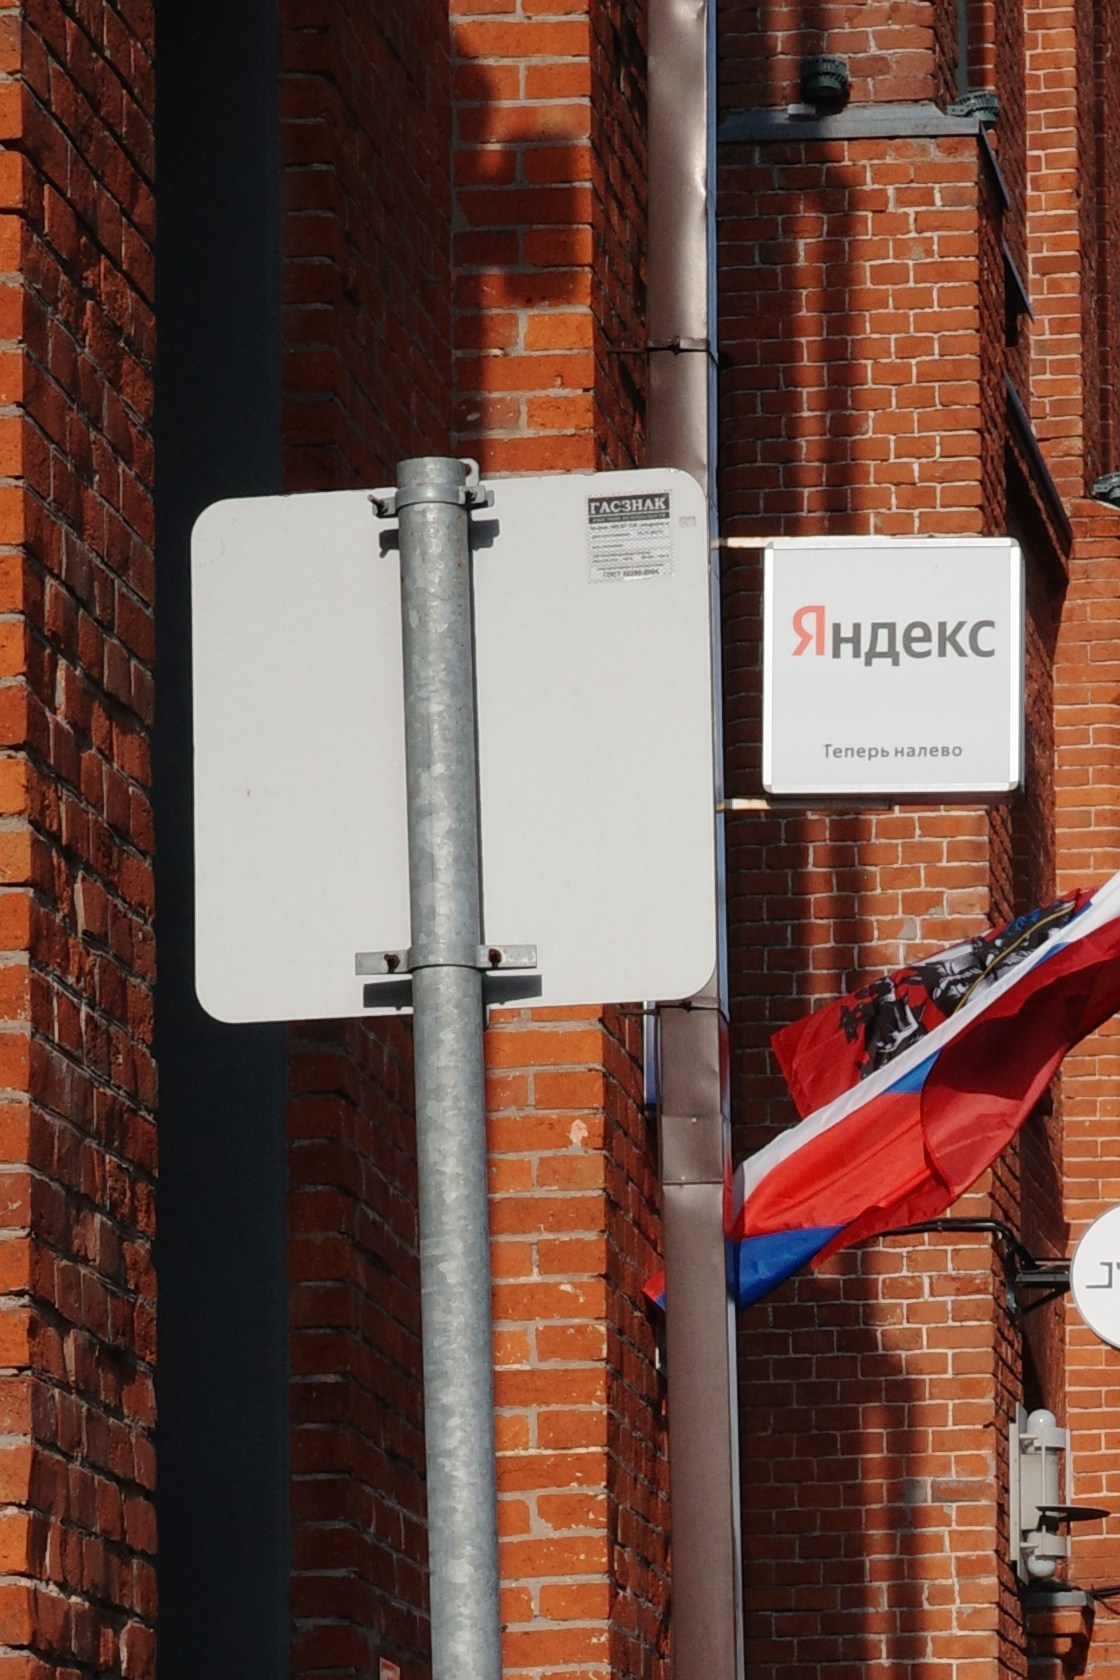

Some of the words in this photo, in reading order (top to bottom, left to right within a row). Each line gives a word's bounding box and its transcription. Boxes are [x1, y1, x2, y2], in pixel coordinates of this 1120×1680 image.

[590, 497, 666, 514] ГАСЗНАК
[791, 605, 996, 667] Яндекс
[824, 743, 890, 761] Теперь
[894, 744, 963, 759] налево
